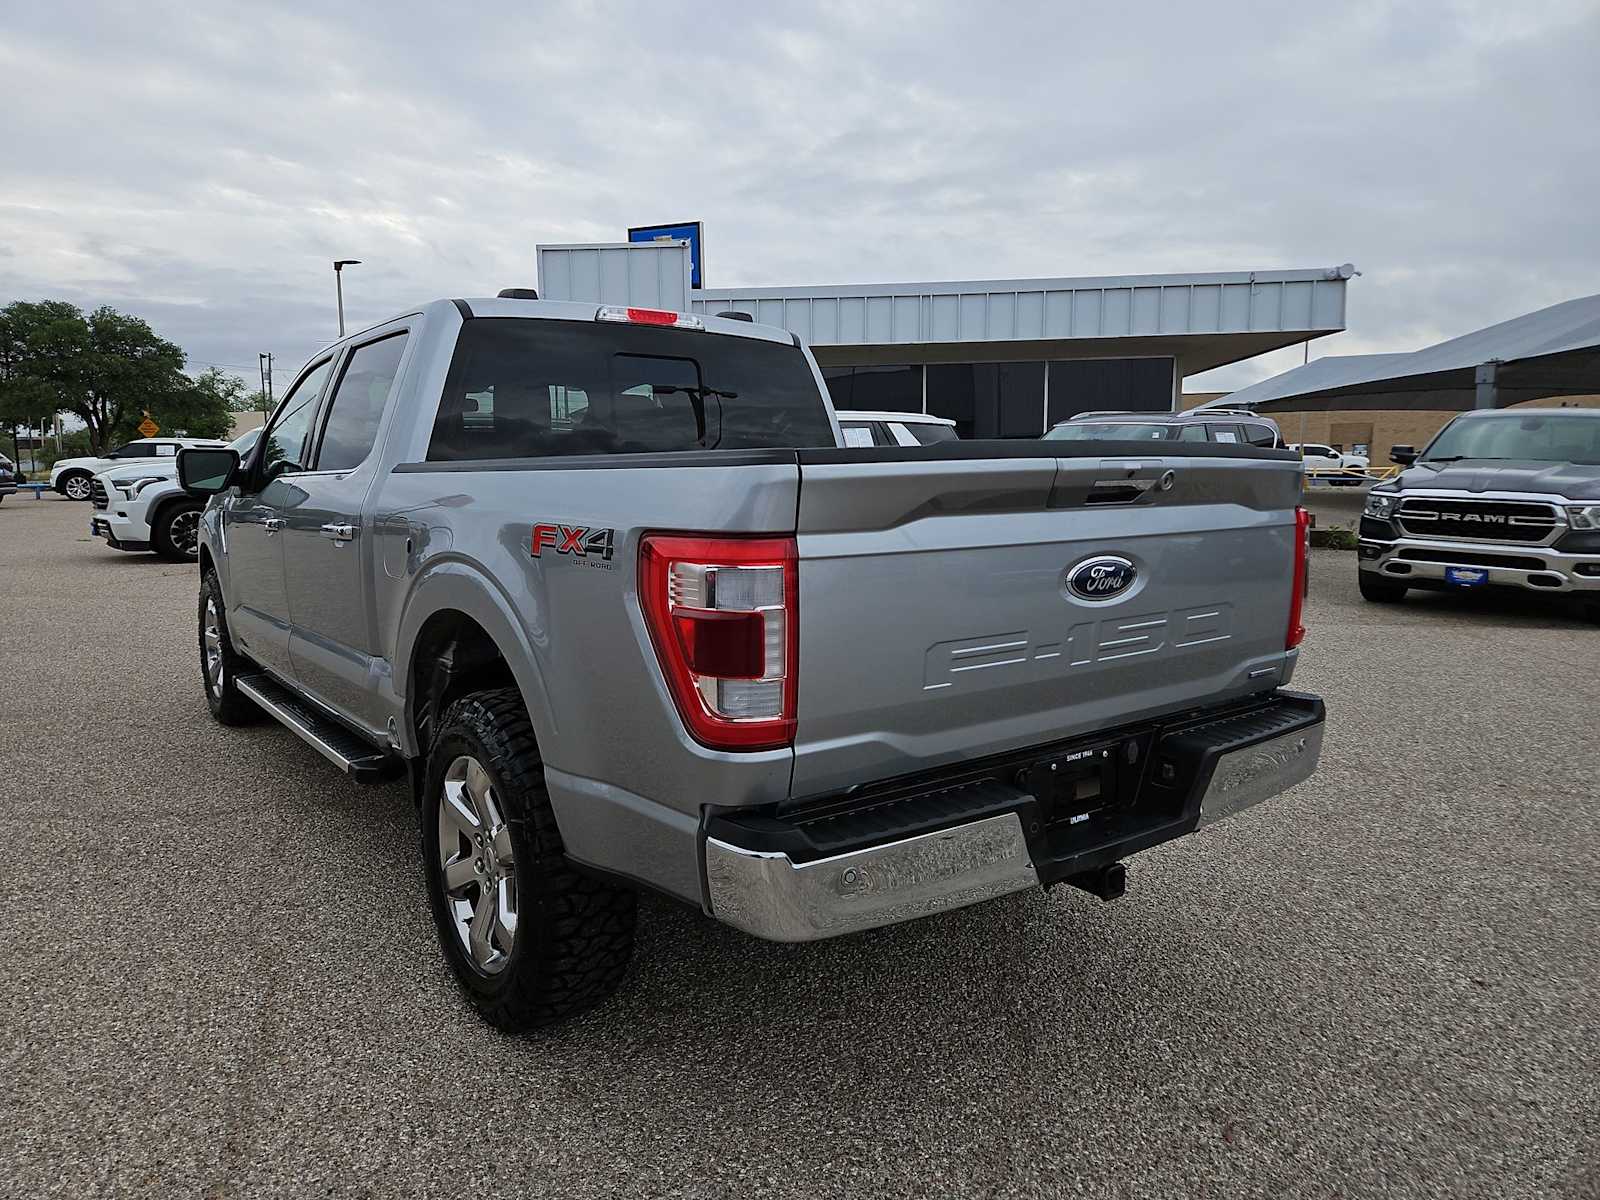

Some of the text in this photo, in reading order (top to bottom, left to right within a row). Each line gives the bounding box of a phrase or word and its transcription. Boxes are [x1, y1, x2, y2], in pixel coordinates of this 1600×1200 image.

[1441, 512, 1506, 524] RAM
[531, 522, 615, 561] FX4
[1086, 565, 1125, 592] Ford
[922, 601, 1234, 690] F-150
[1066, 751, 1082, 762] SINCE
